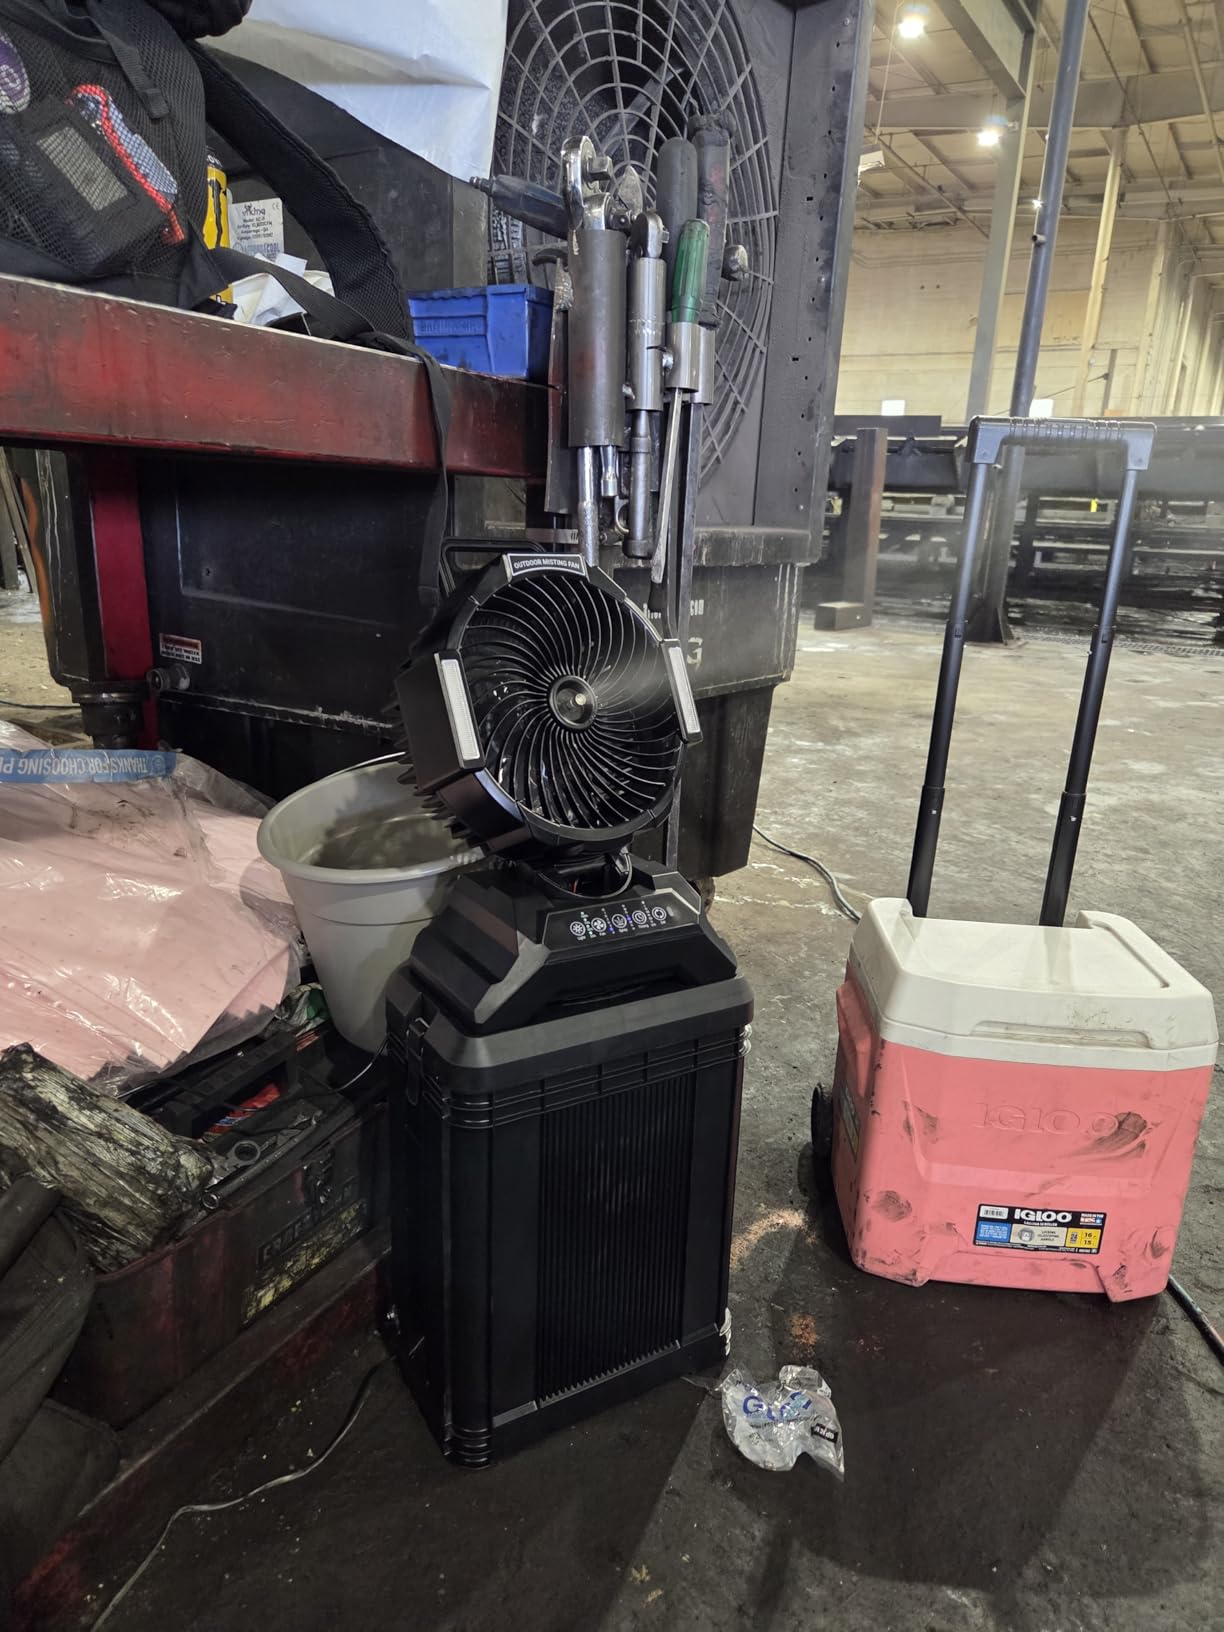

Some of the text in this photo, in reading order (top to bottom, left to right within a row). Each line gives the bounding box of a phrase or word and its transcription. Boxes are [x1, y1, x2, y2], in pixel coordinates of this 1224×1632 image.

[513, 558, 580, 570] OUTDOOR MISTING FAN
[18, 756, 86, 775] CHOOSING
[88, 755, 111, 774] FOR
[112, 755, 148, 773] THANKS
[1014, 1208, 1072, 1223] IGLOO
